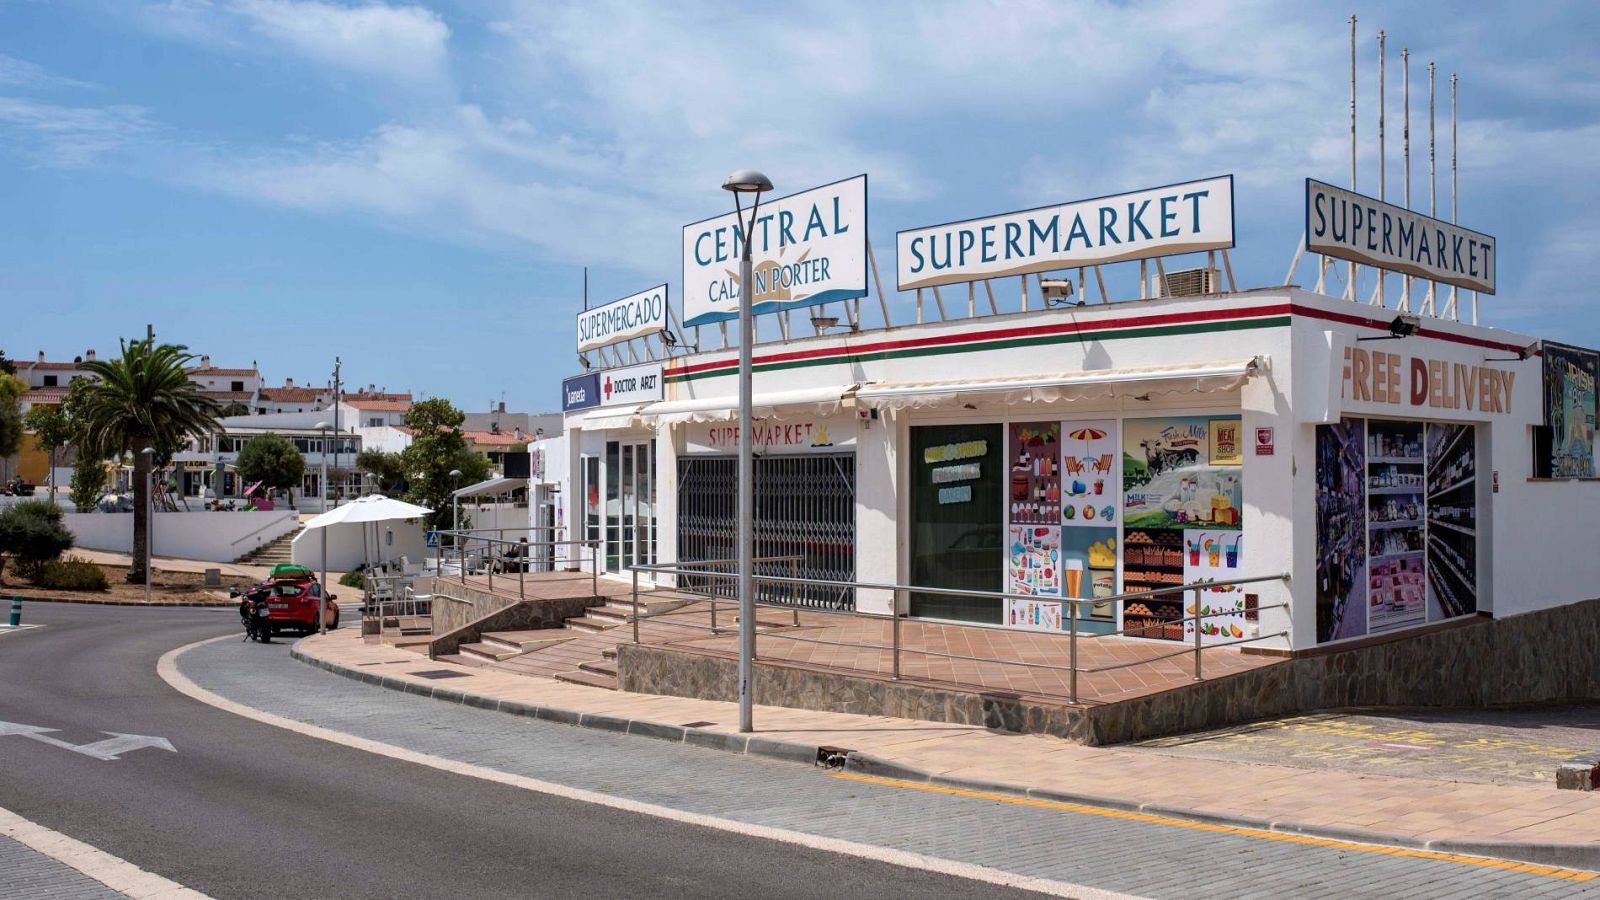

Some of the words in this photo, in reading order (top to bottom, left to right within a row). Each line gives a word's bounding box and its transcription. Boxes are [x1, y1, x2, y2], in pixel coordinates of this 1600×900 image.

[694, 196, 849, 267] CENTRAL
[910, 190, 1210, 273] SUPERMARKET
[1314, 192, 1491, 281] SUPERMARKET
[772, 257, 831, 291] PORTER
[579, 293, 662, 343] SUPERMERCADO
[614, 378, 636, 394] DOCTOR
[640, 374, 657, 390] ARZT
[1341, 346, 1401, 404] FREE
[1410, 357, 1515, 414] DELIVERY
[709, 424, 814, 447] SUPEMARKET
[1217, 428, 1235, 442] MEAT
[1217, 446, 1235, 454] SHOP
